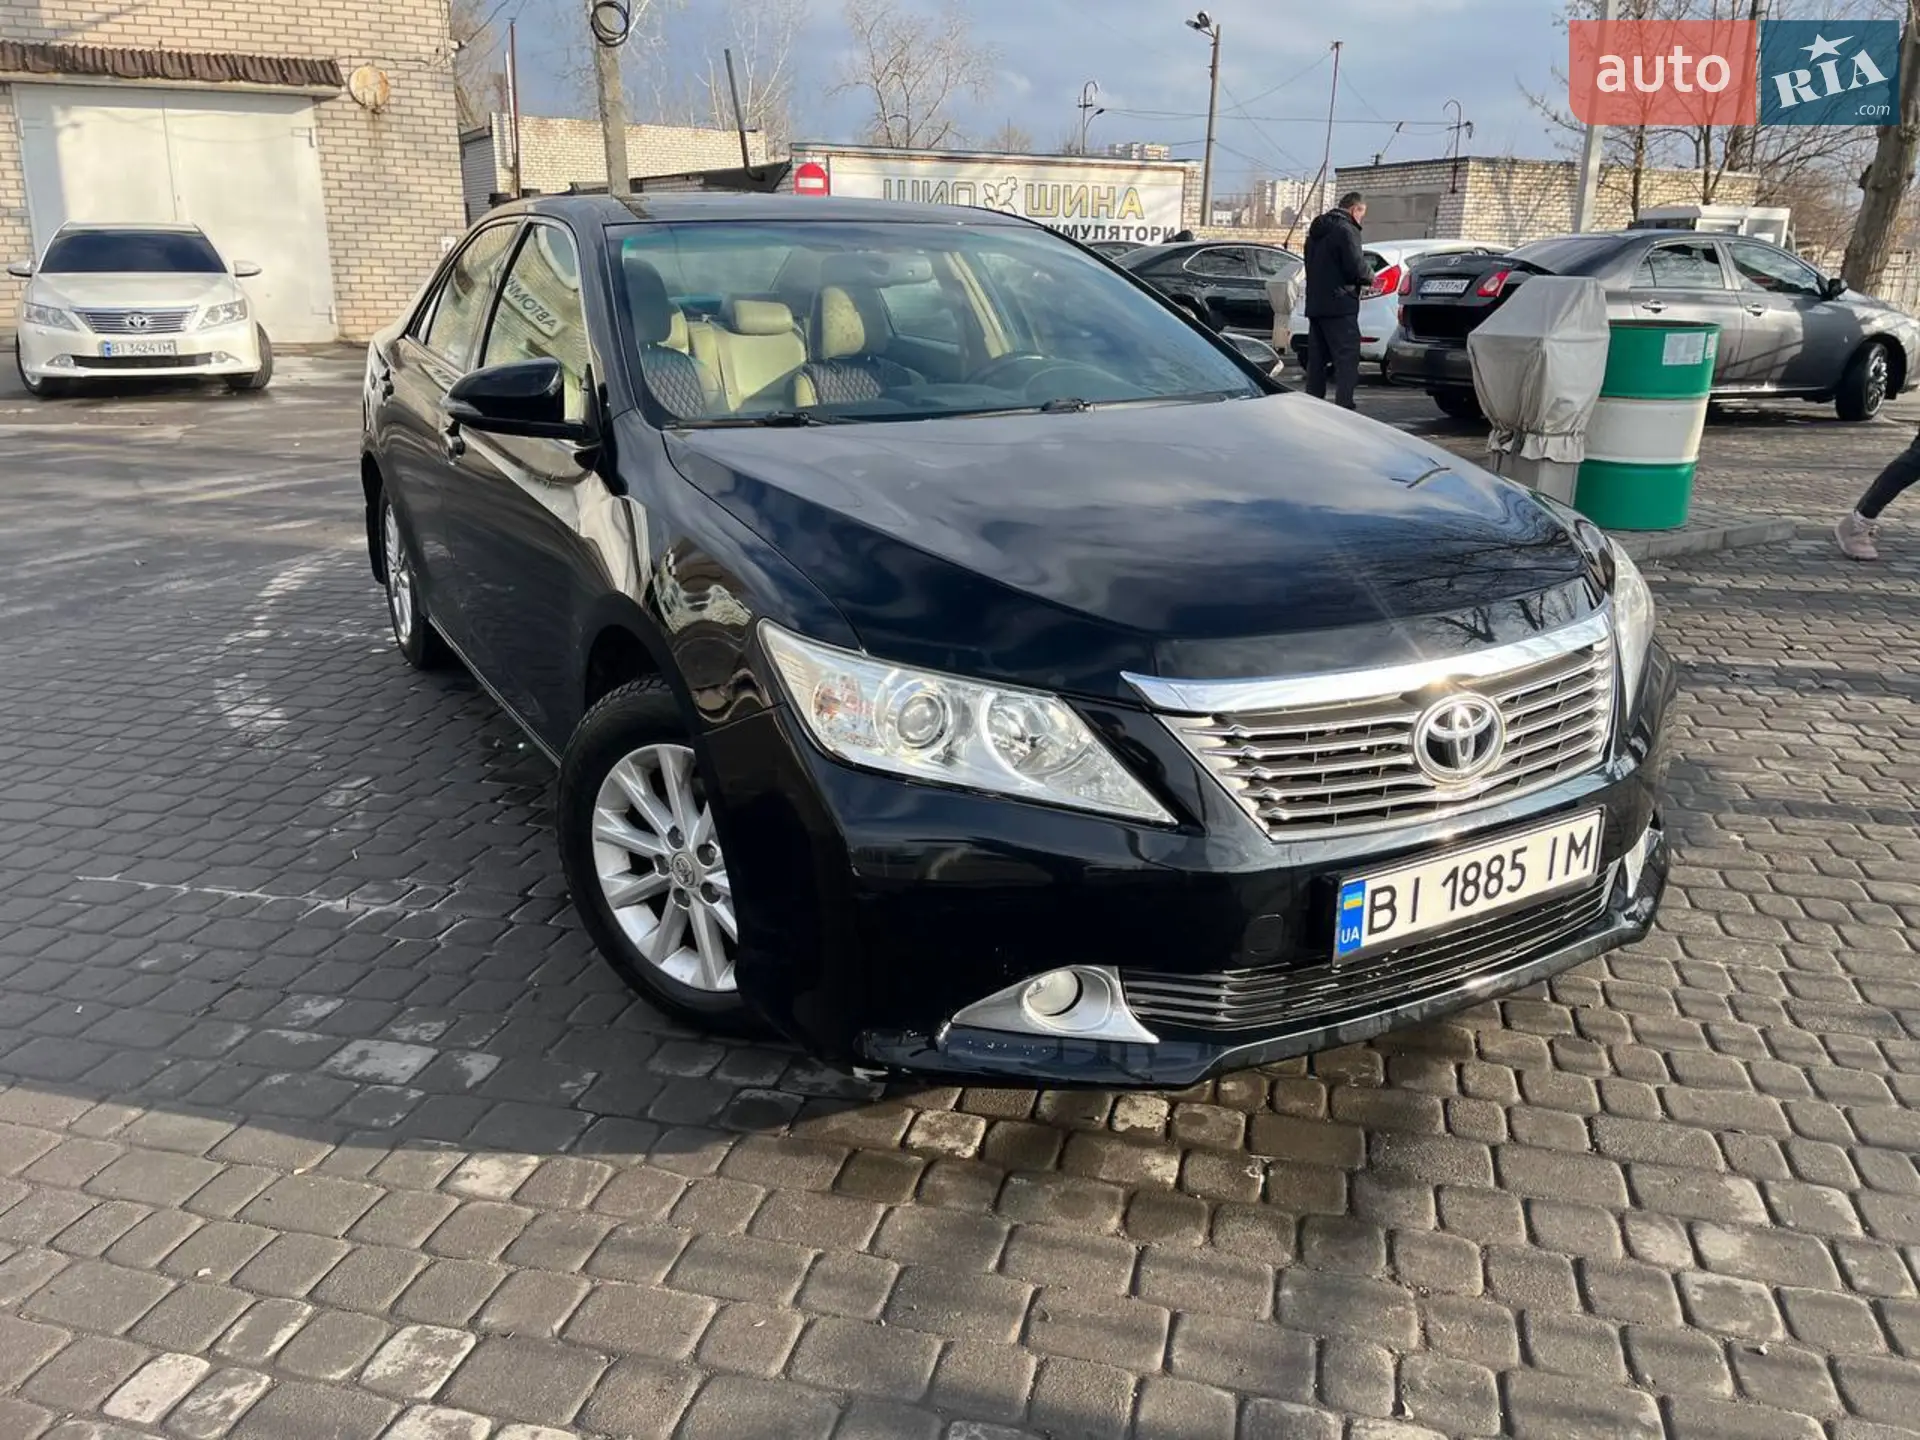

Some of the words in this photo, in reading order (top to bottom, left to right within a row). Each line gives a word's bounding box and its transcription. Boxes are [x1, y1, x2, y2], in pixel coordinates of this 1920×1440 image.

[1024, 182, 1145, 220] ШИНА
[112, 343, 125, 354] BI
[130, 343, 156, 353] 3424
[1367, 876, 1420, 937] BI
[1441, 846, 1528, 911] 1885
[1548, 826, 1593, 881] IM
[1341, 925, 1360, 944] UA
